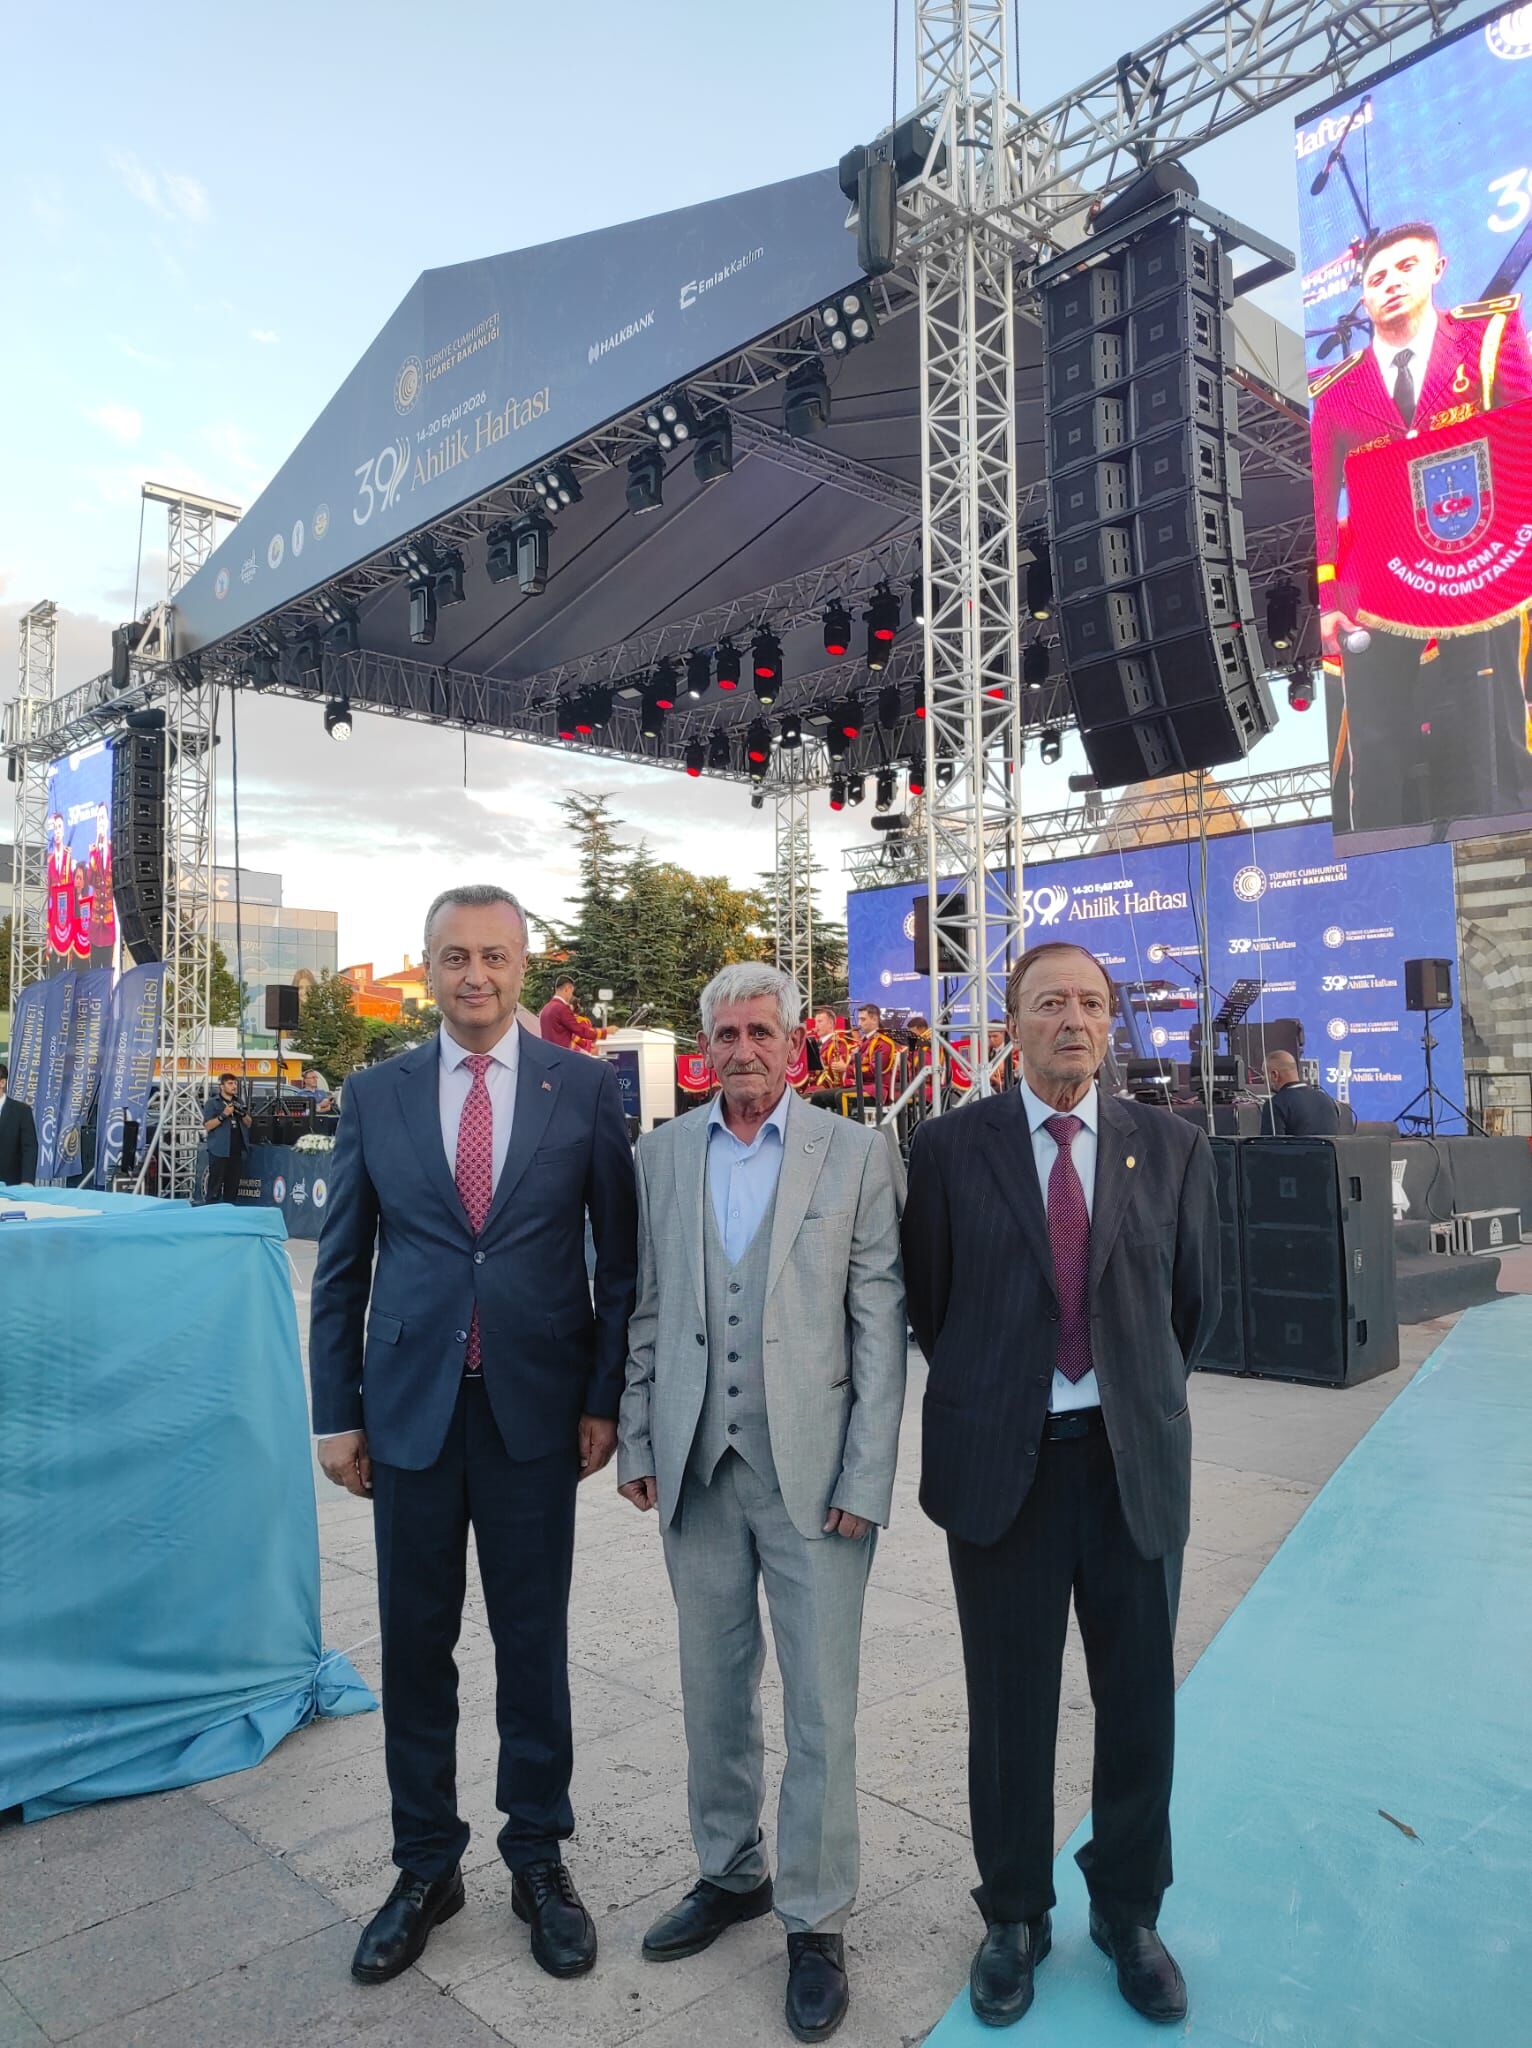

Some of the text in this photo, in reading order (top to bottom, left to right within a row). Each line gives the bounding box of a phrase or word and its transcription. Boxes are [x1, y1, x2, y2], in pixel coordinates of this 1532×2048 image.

[1488, 167, 1532, 233] 3
[424, 327, 500, 384] TİCARET BAKANLIĞI
[425, 312, 500, 370] TÜRKİYE CUMHURİYETİ
[600, 309, 655, 356] HALKBANK
[441, 407, 462, 430] Eylül
[463, 390, 487, 415] 2026
[410, 387, 551, 492] Ahilik Haftası
[1387, 557, 1437, 595] BANDO
[1415, 541, 1505, 579] JANDARMA
[1113, 879, 1134, 890] 2026
[1269, 864, 1347, 881] TÜRKİYE CUMHURİYETİ
[1269, 873, 1348, 889] TİCARET BAKANLIĞI
[1068, 890, 1188, 922] Ahilik Haftası
[87, 997, 102, 1066] BAKANLIĞI
[127, 977, 160, 1107] Ahilik Haftası
[114, 1031, 129, 1101] 14-20 Eylül 2026
